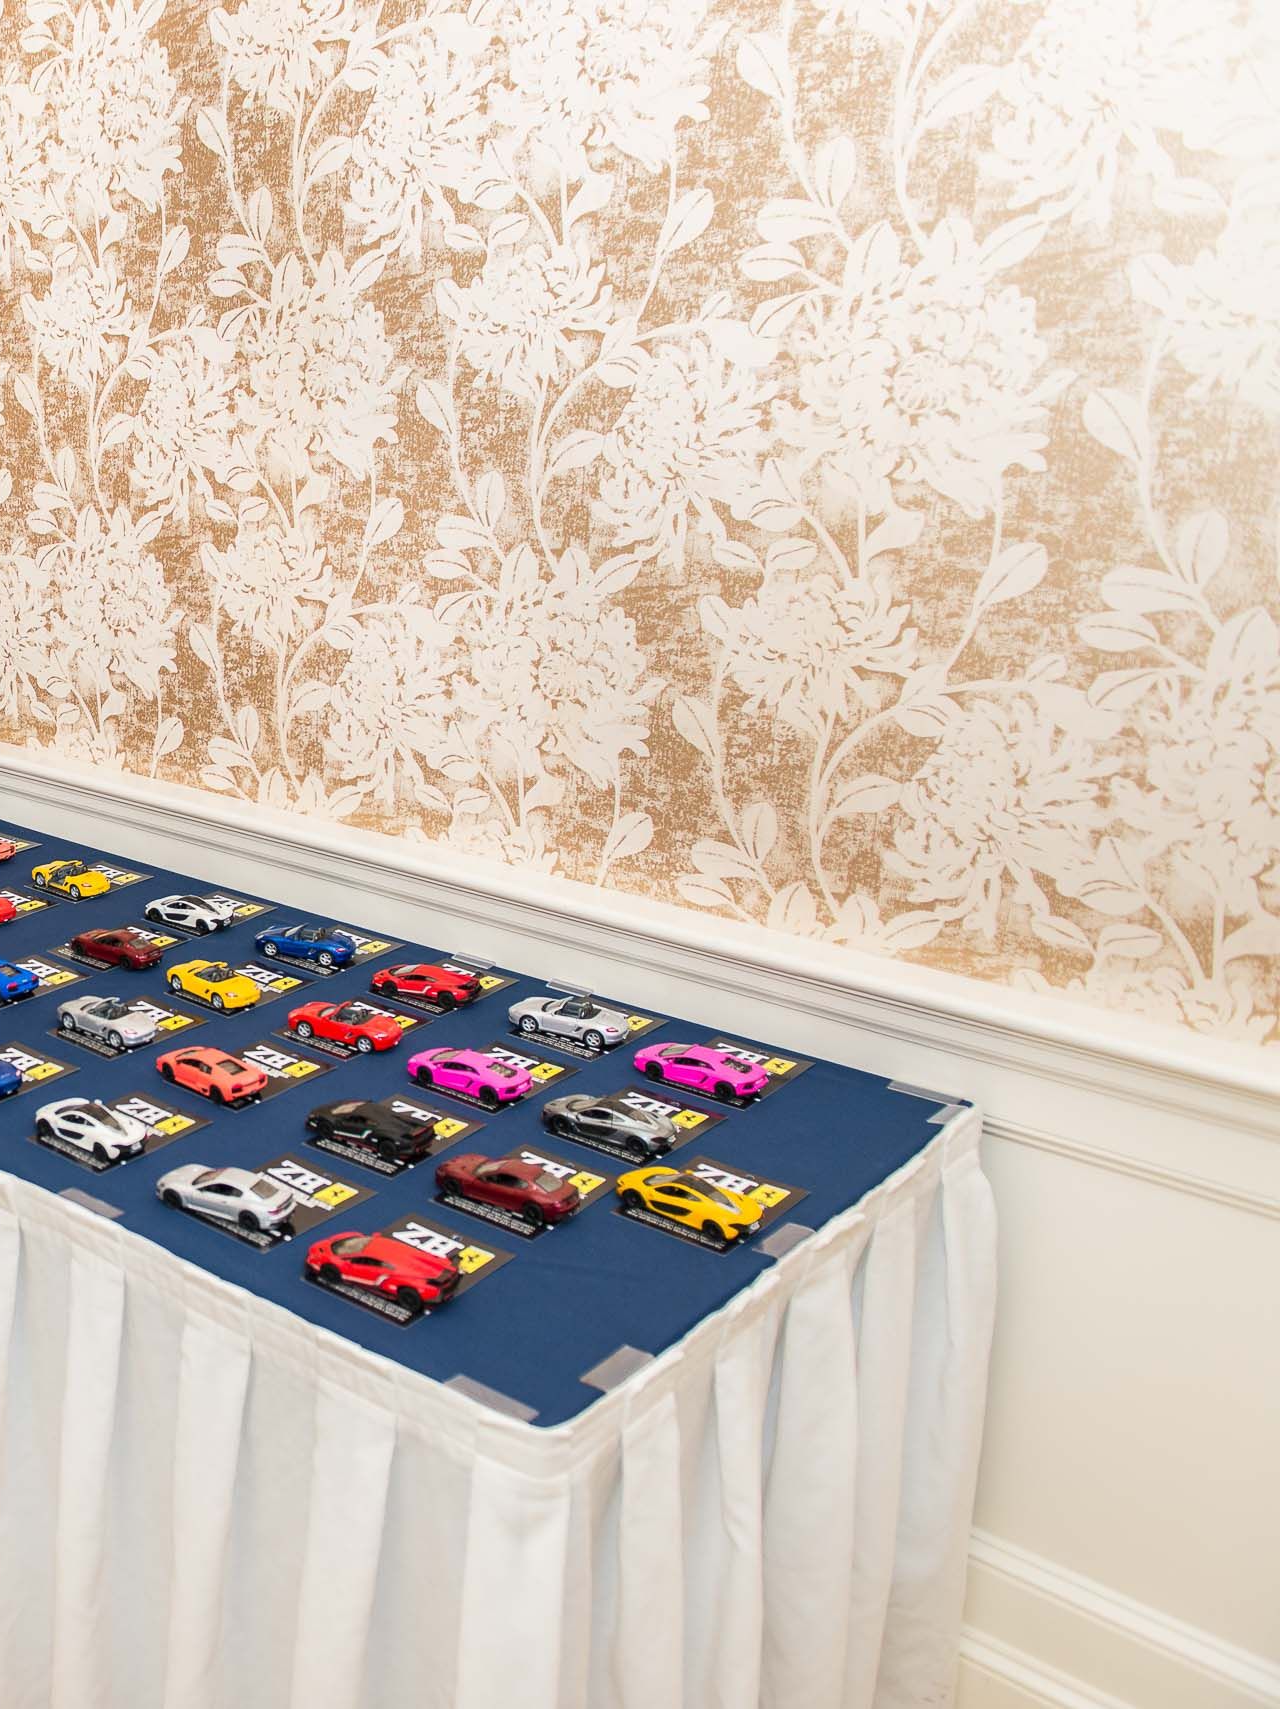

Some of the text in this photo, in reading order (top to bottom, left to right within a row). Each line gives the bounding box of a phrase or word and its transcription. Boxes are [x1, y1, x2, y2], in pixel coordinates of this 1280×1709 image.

[16, 959, 61, 979] ZH
[235, 964, 284, 984] ZH
[243, 1045, 298, 1069] ZH
[483, 1047, 540, 1069] ZH
[115, 1098, 173, 1126] ZH
[621, 1091, 681, 1116] ZH
[268, 1160, 333, 1193] ZH
[692, 1164, 759, 1193] ZH
[393, 1222, 465, 1258] ZH
